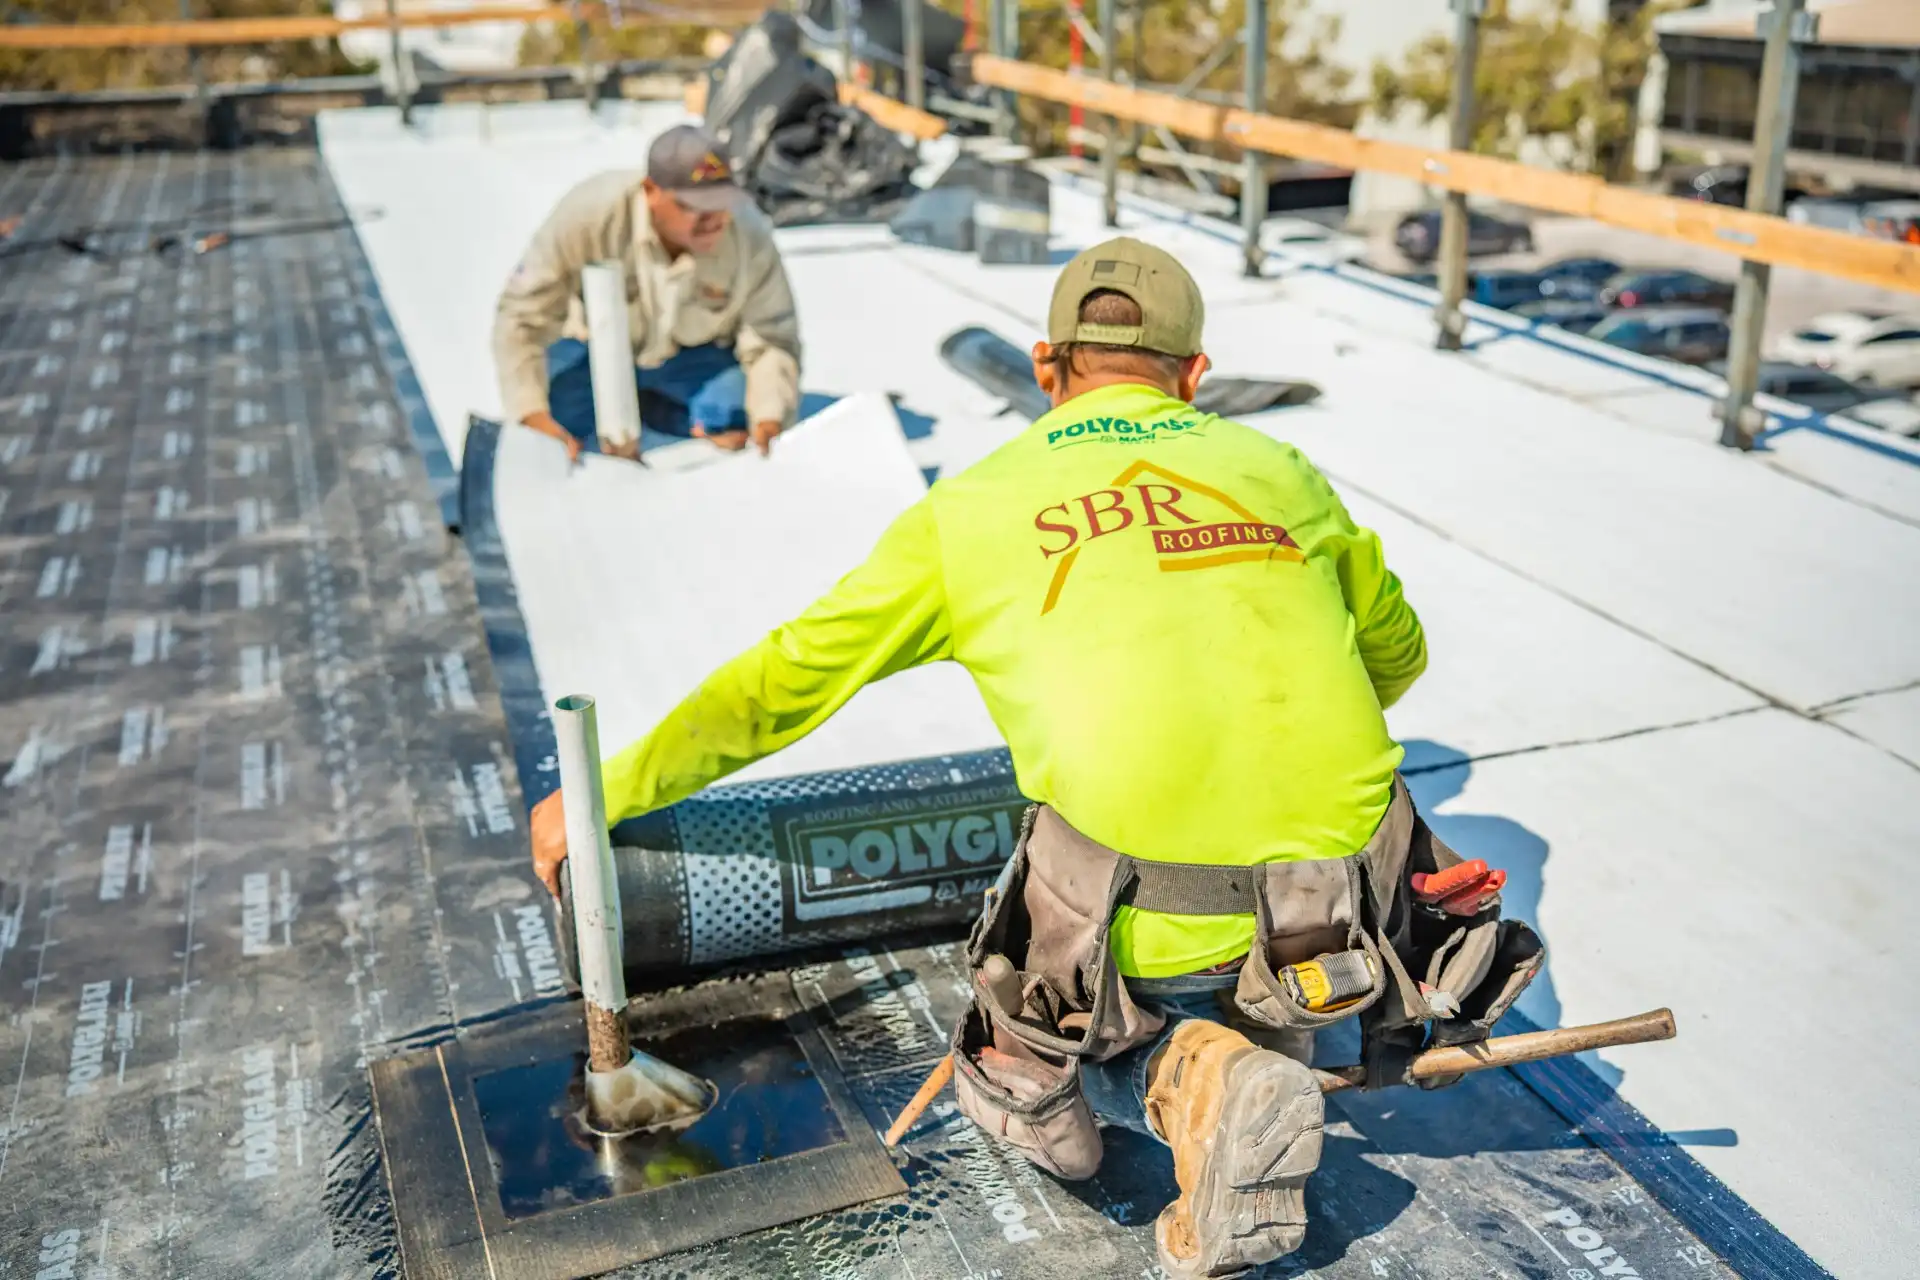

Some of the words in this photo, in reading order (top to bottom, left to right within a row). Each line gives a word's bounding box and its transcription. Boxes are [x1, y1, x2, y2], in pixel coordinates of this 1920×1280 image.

[1034, 484, 1201, 560] SBR
[1160, 526, 1277, 550] ROOFING
[1543, 1206, 1644, 1280] POLY
